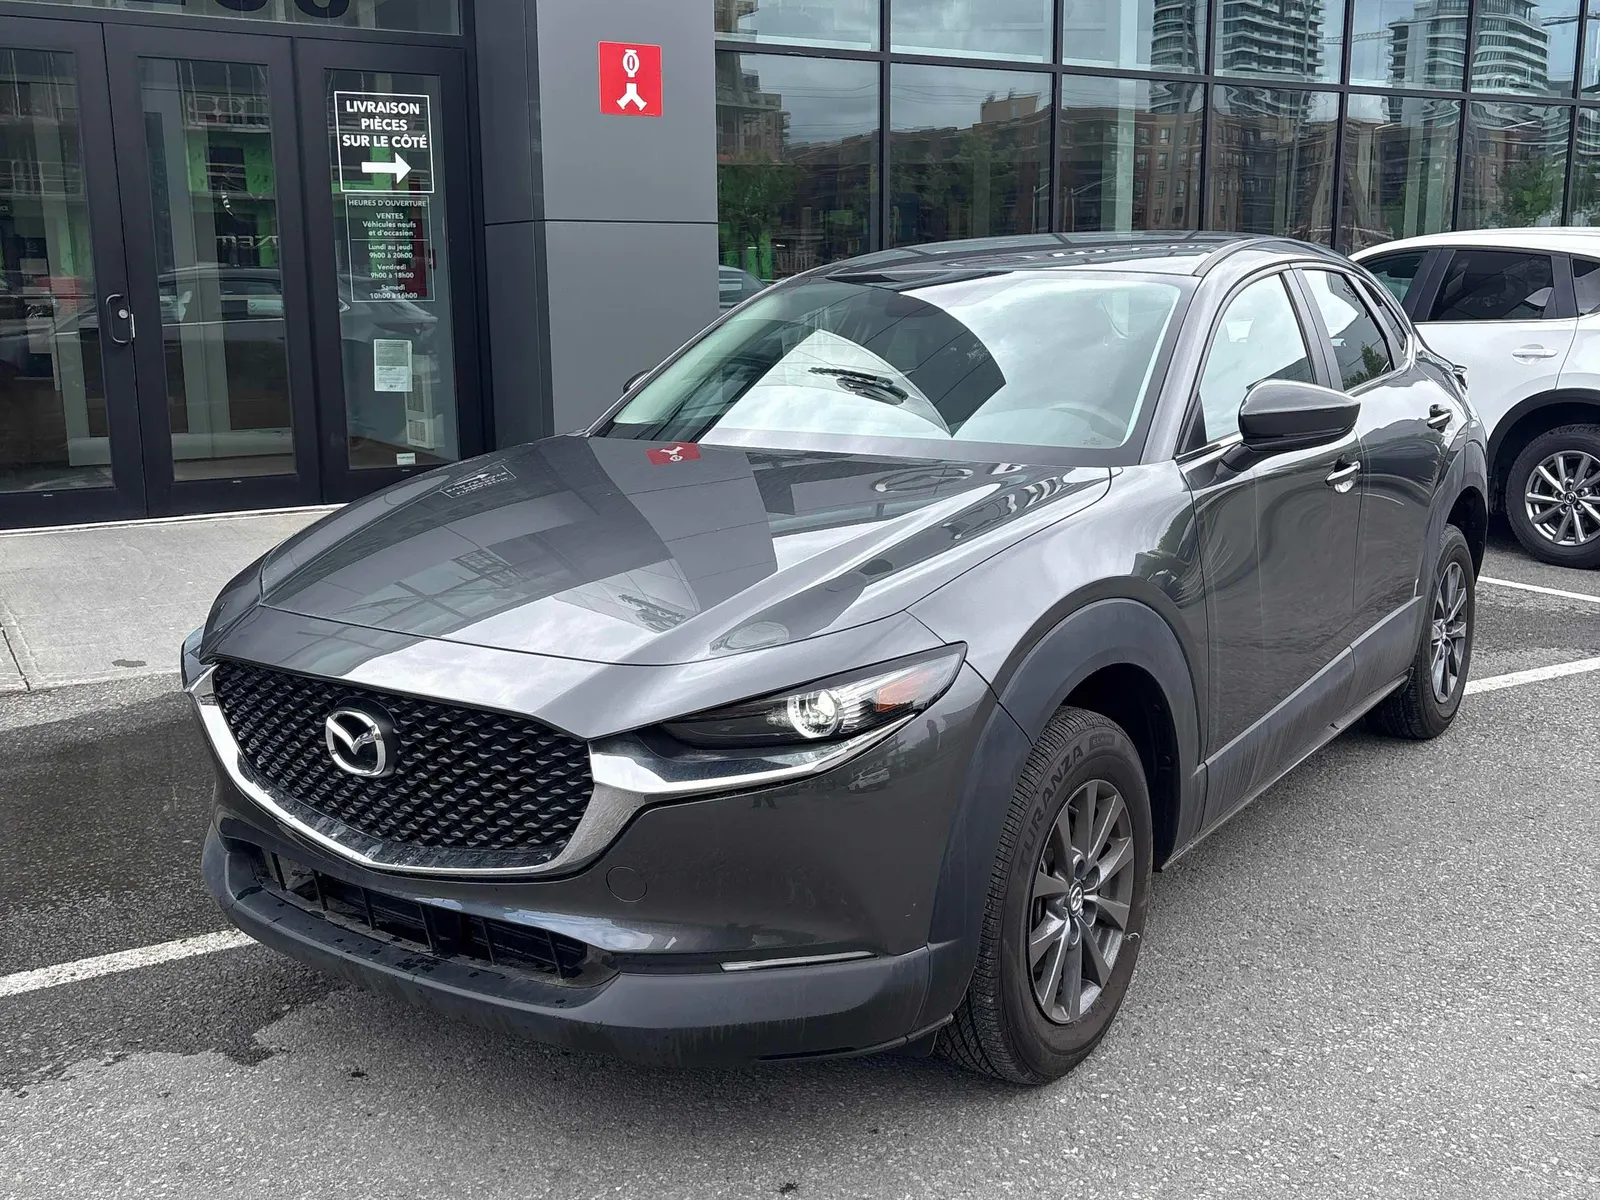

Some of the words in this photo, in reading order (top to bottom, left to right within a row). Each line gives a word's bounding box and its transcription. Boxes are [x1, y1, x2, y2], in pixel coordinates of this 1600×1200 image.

[346, 100, 420, 115] LIVRAISON
[361, 115, 408, 131] PIÈCES
[342, 134, 370, 147] SUR
[373, 135, 389, 147] LE
[391, 133, 428, 148] CÔTÉ
[348, 199, 377, 207] HEURES
[378, 199, 427, 207] D'OUVERTURE
[396, 243, 413, 252] jeudi
[1018, 745, 1085, 872] TURANZA
